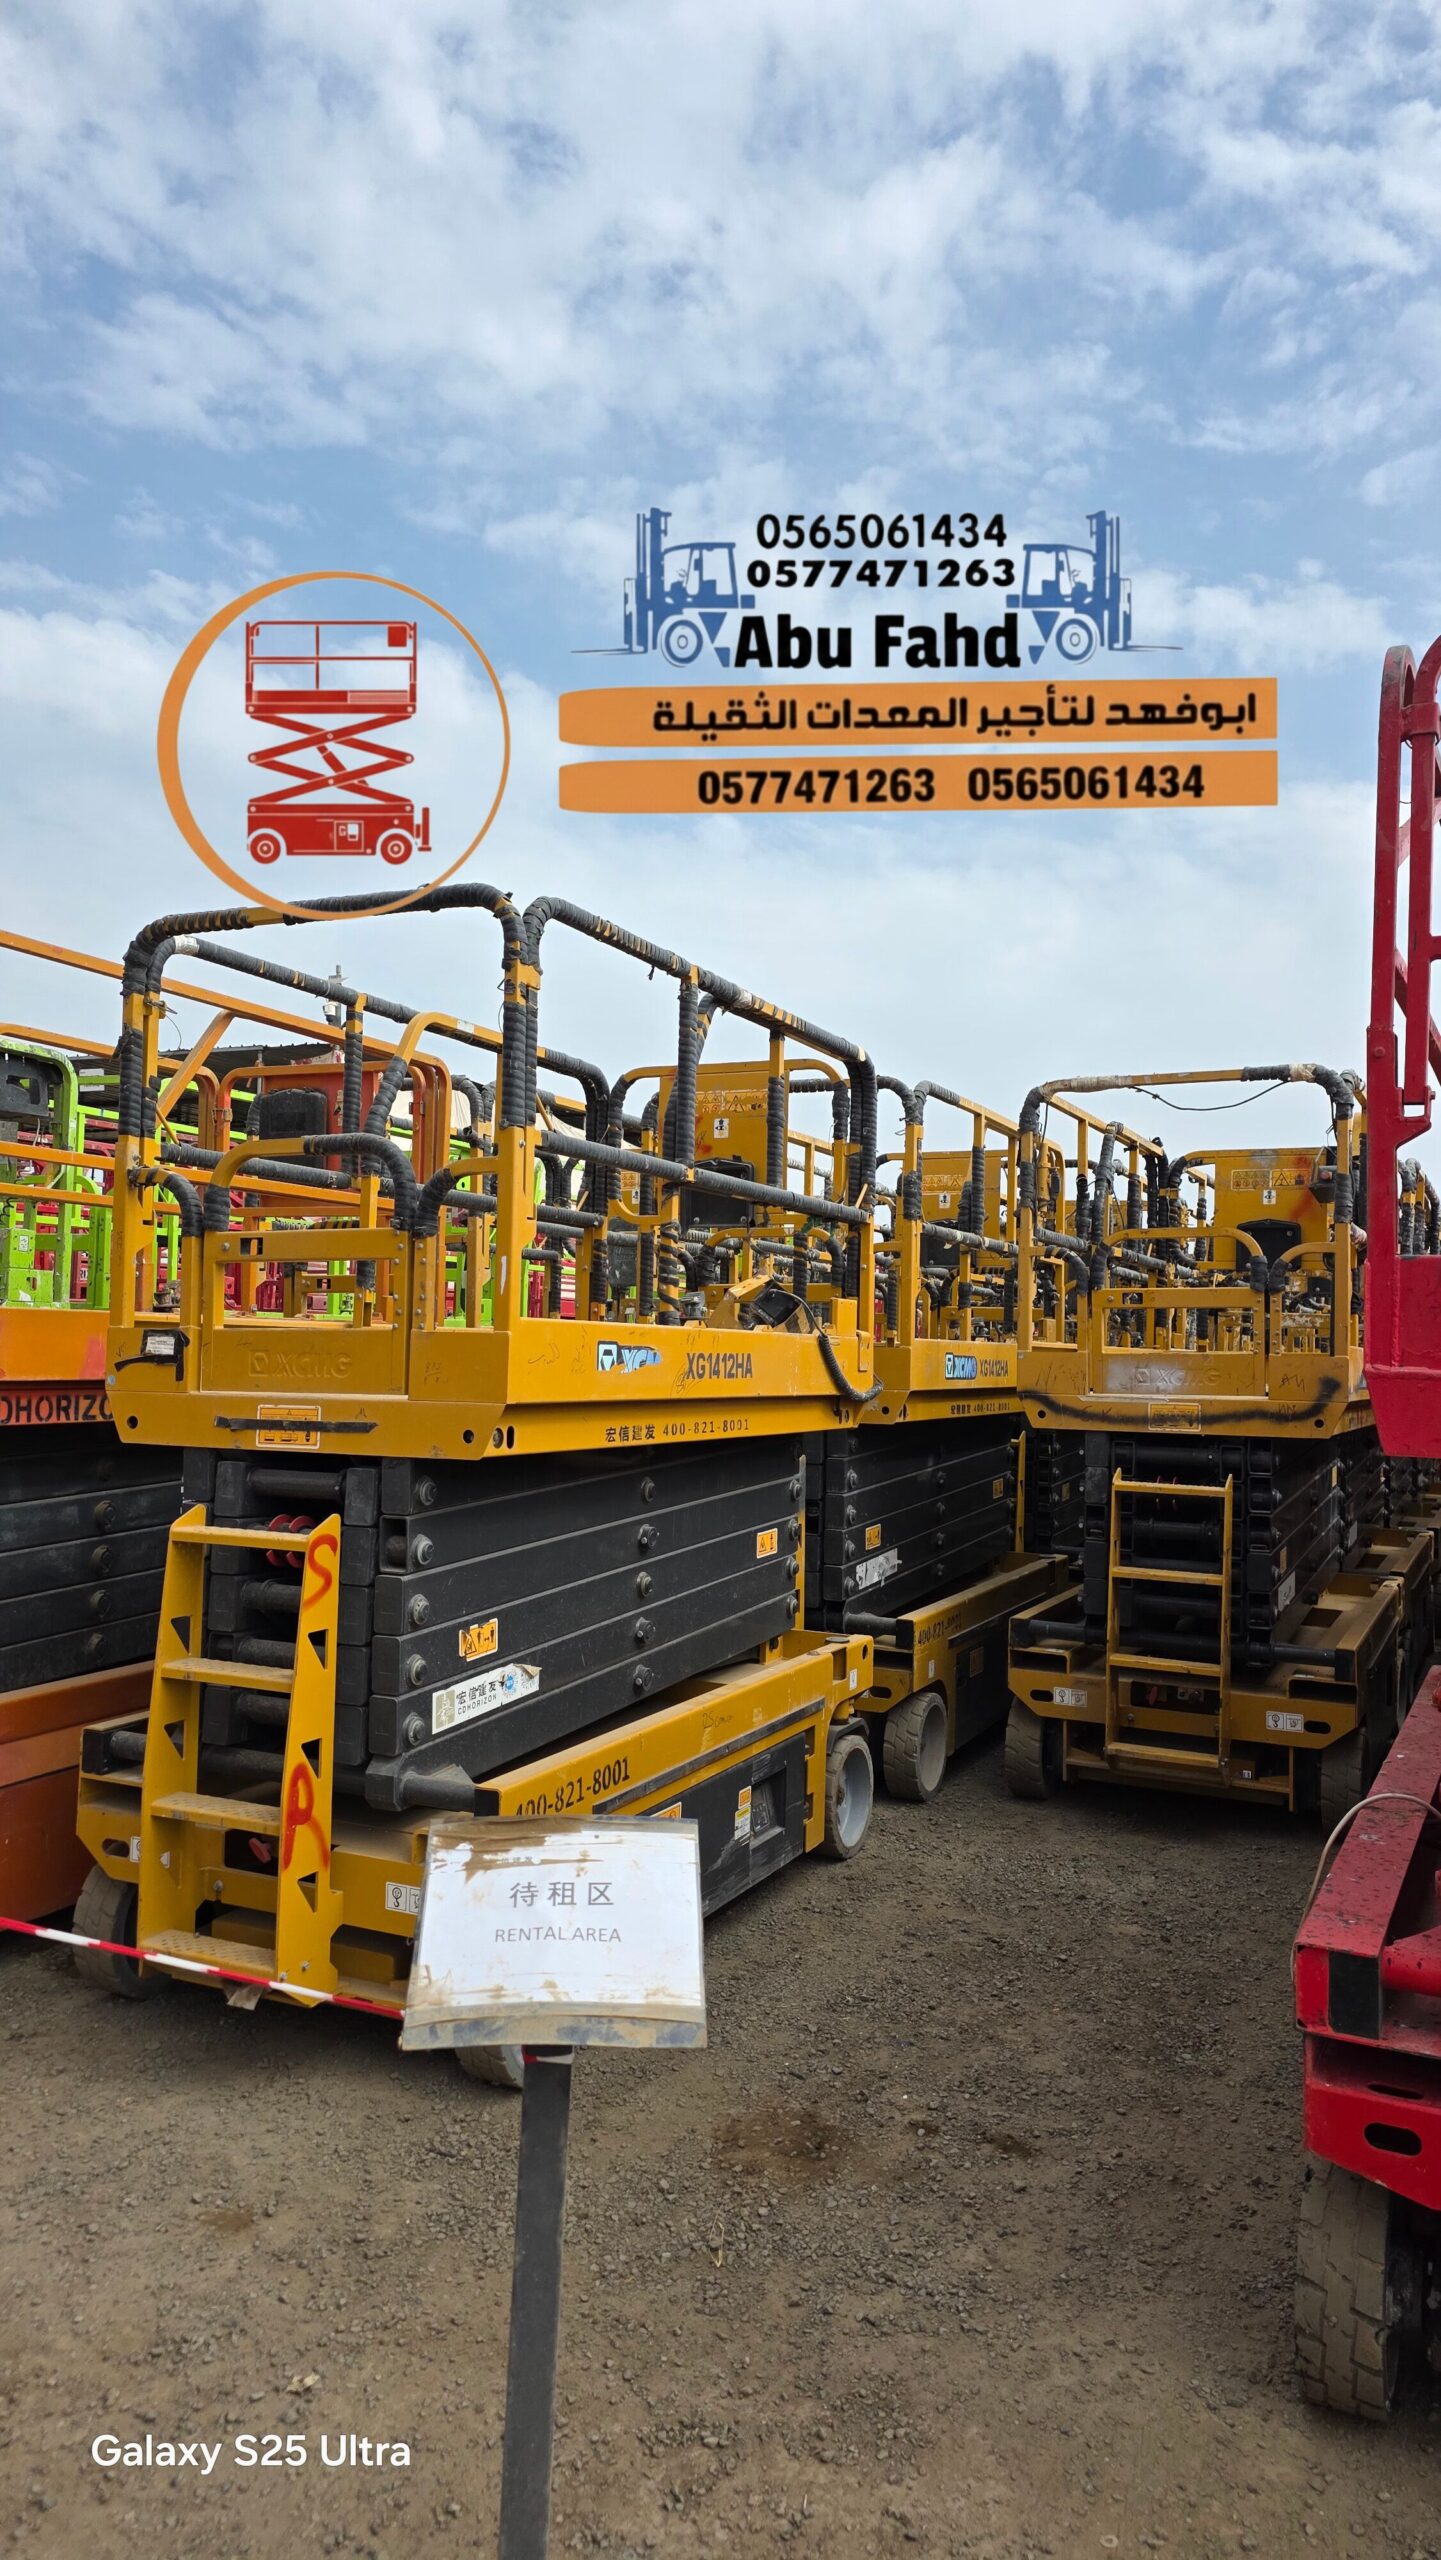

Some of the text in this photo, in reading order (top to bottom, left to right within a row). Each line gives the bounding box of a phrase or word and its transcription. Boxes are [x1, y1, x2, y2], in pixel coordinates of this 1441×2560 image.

[686, 1352, 753, 1380] XG1412HA
[605, 1418, 750, 1443] 宏信建发 400-821-8001
[302, 1533, 338, 1612] S
[509, 1881, 614, 1908] 待租区
